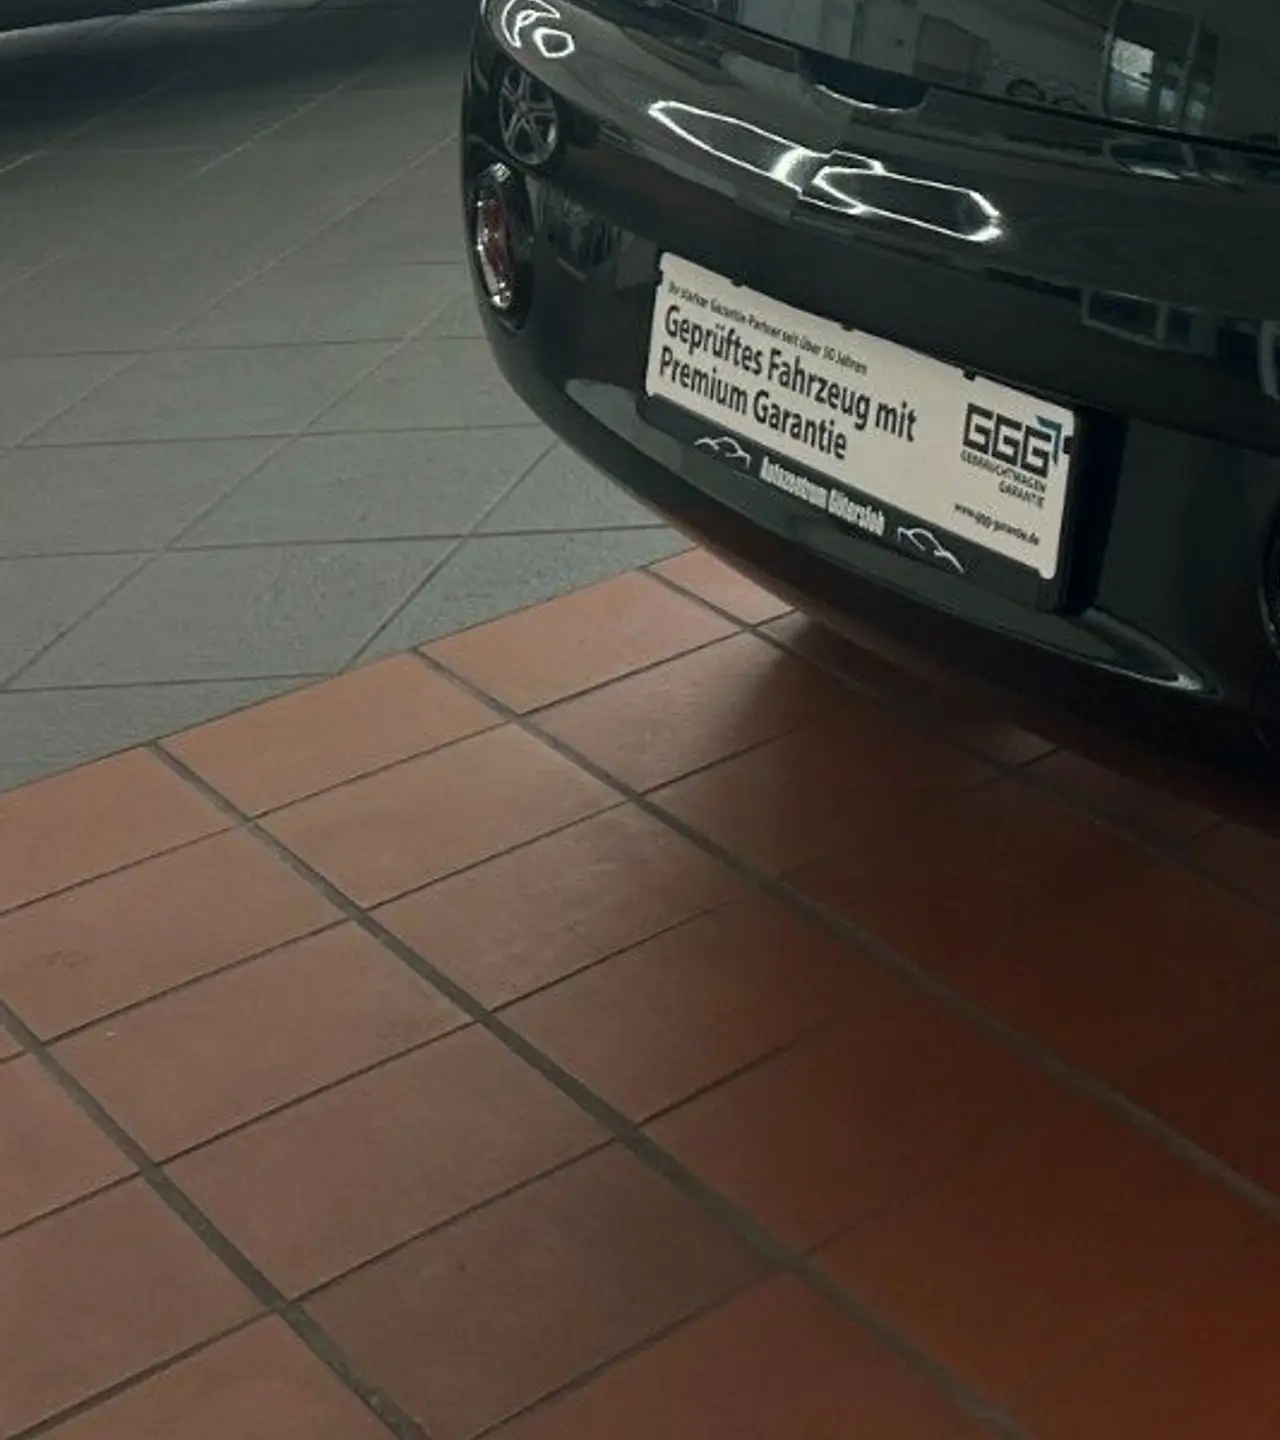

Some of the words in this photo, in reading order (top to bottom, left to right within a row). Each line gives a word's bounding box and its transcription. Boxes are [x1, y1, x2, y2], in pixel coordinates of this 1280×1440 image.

[660, 346, 748, 416] Premium
[753, 389, 848, 460] Garantie
[665, 304, 764, 376] Geprüftes
[767, 348, 871, 432] Fahrzeug
[875, 401, 917, 442] mit
[963, 402, 1053, 478] GGG
